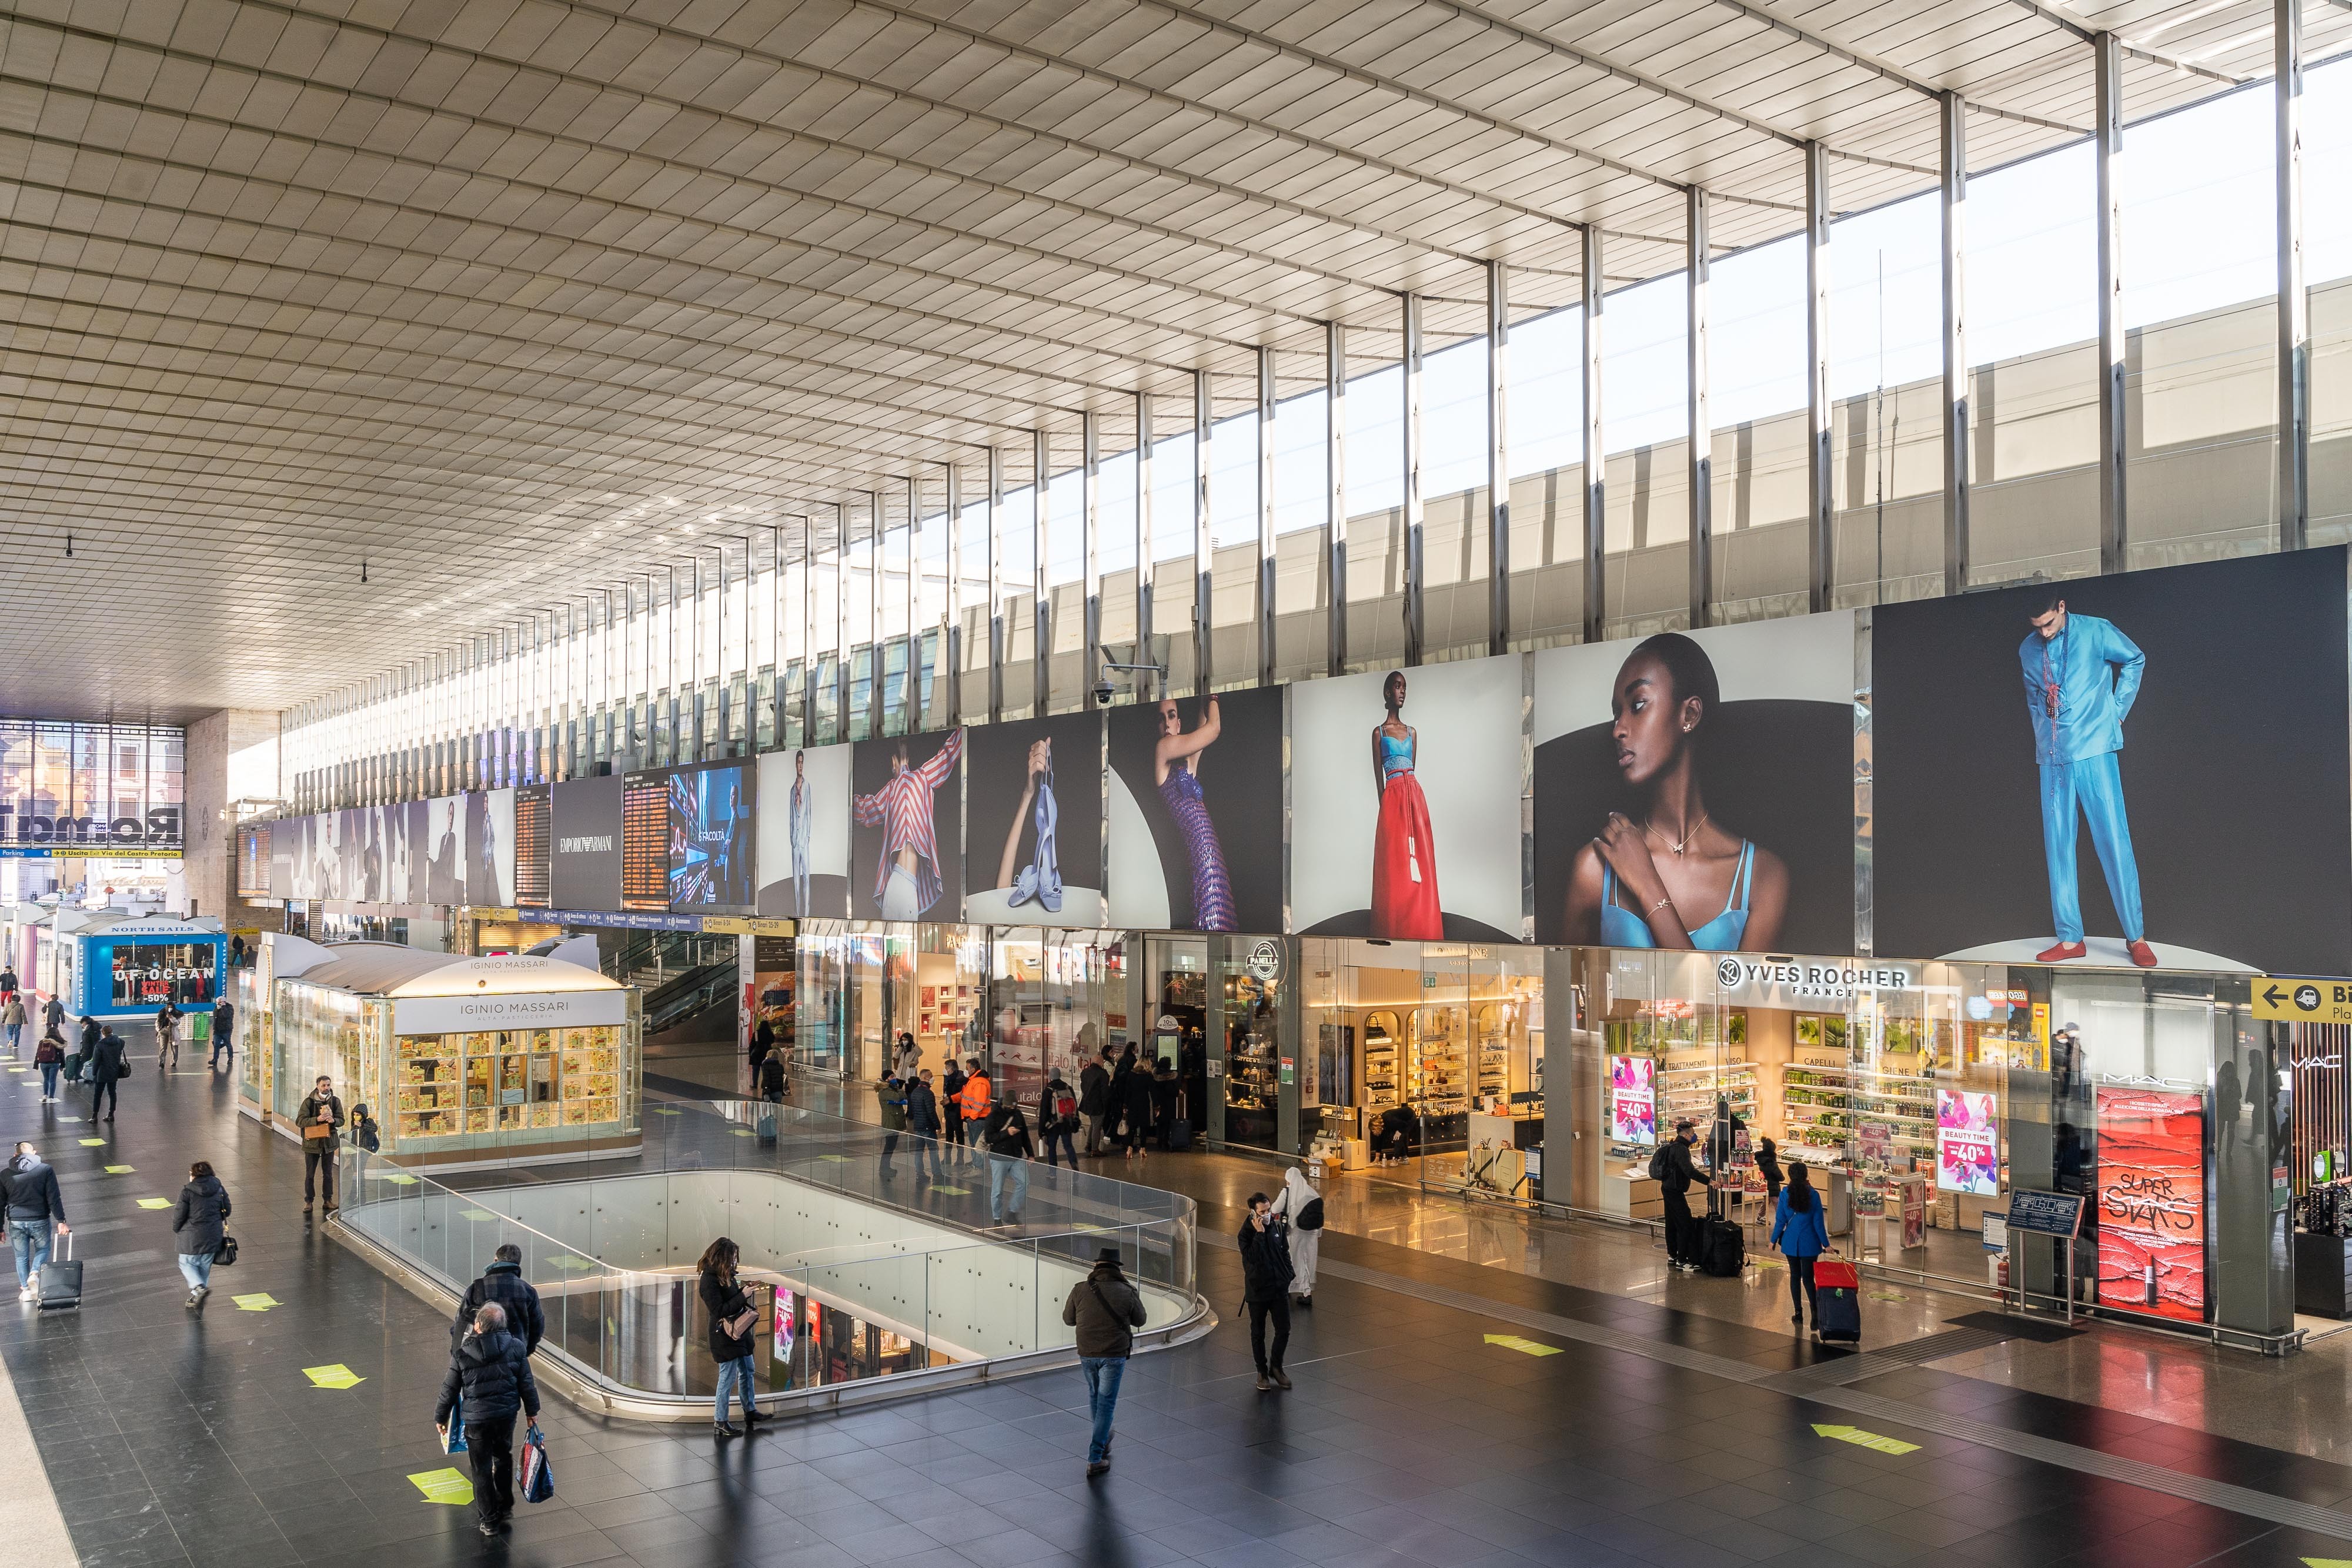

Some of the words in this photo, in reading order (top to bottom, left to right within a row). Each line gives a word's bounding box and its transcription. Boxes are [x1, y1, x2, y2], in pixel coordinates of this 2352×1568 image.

[702, 828, 725, 841] FACOLTÀ
[560, 837, 583, 852] EMPORIO
[590, 835, 612, 851] ARMANI
[115, 969, 139, 981] OF
[149, 967, 213, 980] OCEAN
[1746, 965, 1800, 982] YVES
[1809, 968, 1906, 988] ROCHER
[142, 986, 170, 995] SALE
[1793, 987, 1852, 997] FRANCE
[460, 1004, 504, 1014] IGINIO
[510, 1002, 569, 1012] MASSARI
[1234, 1054, 1252, 1062] COFFEE
[1804, 1058, 1836, 1068] CAPELLI
[1668, 1060, 1707, 1071] TRATTAMENTI
[1882, 1066, 1910, 1076] GIENE
[1622, 1102, 1646, 1117] -40%
[1945, 1131, 1971, 1139] BEAUTY
[1950, 1144, 1985, 1162] -40%
[2121, 1174, 2174, 1195] SUPER
[2106, 1186, 2194, 1231] STARS
